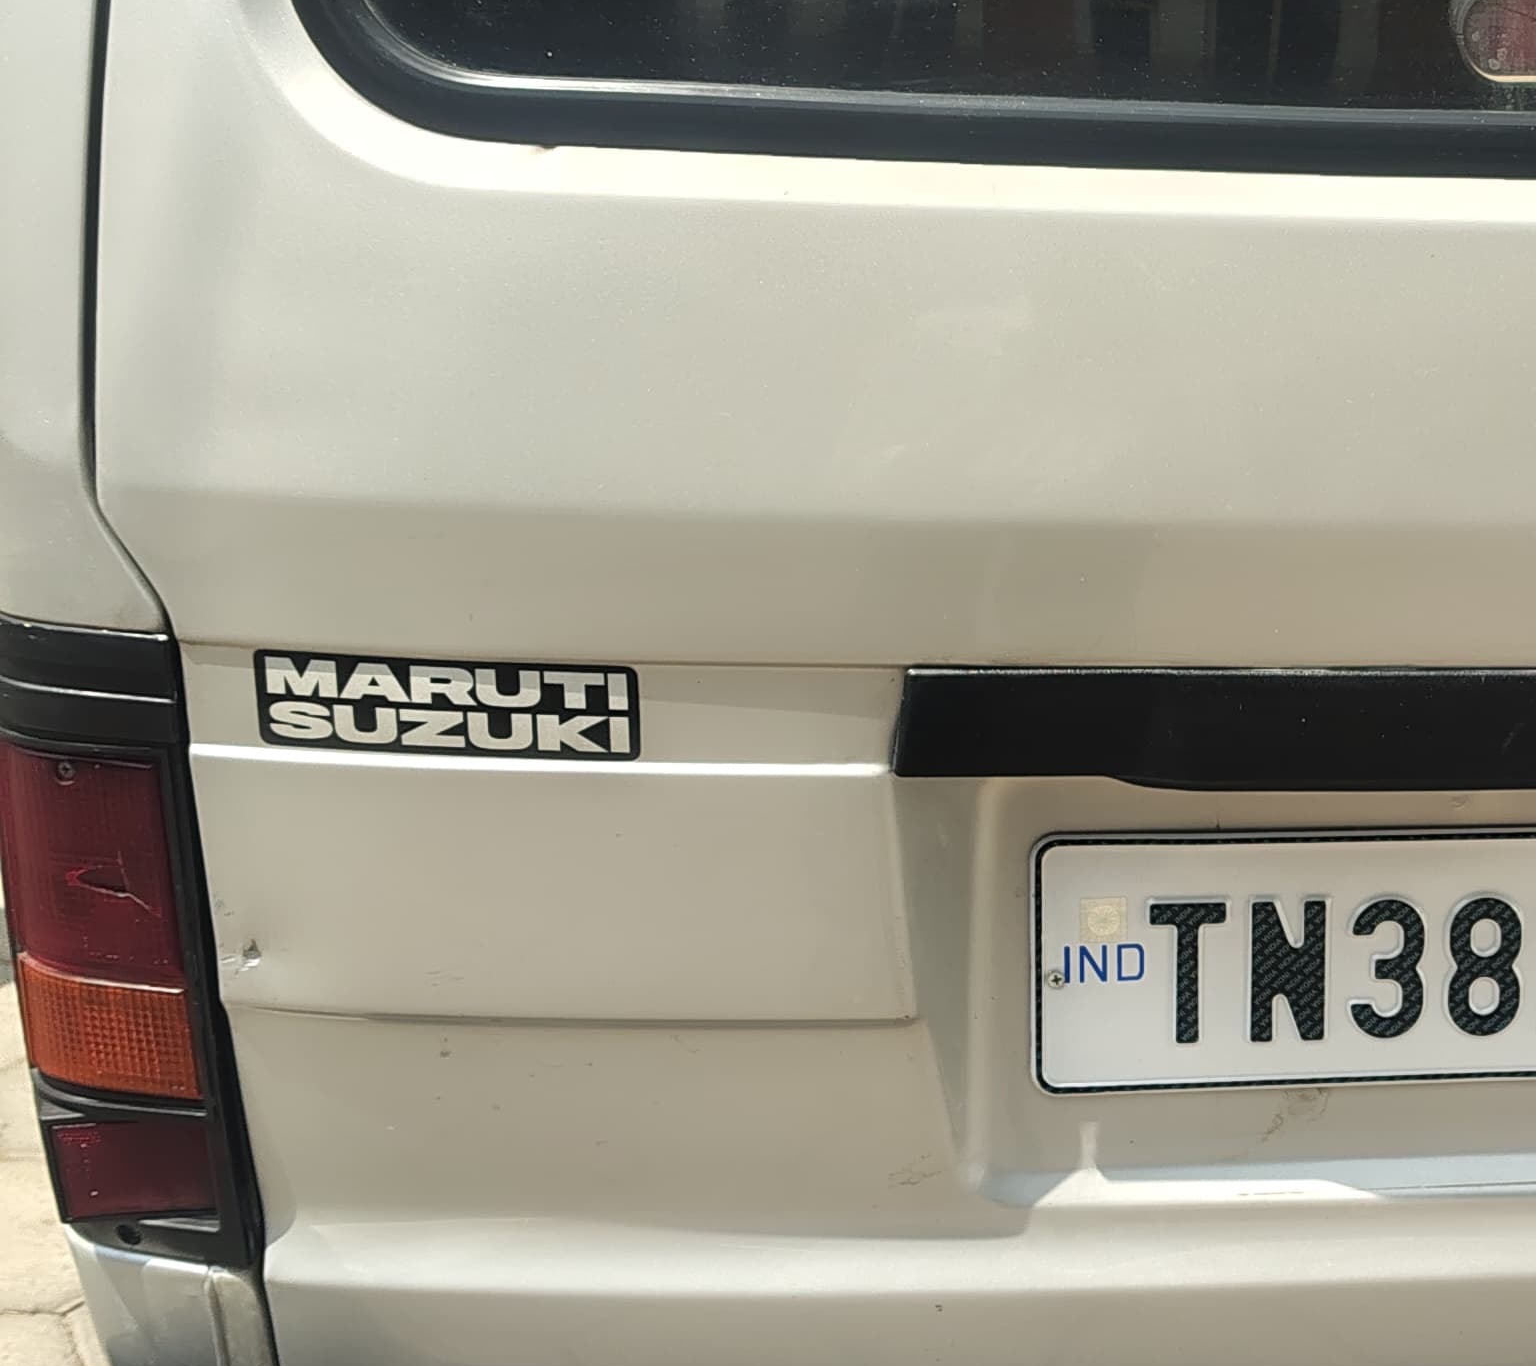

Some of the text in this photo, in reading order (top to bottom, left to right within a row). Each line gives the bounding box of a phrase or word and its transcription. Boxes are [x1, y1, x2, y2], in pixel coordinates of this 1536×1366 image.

[263, 655, 630, 711] MARUTI
[268, 700, 631, 754] SUZUKI
[1063, 943, 1145, 984] IND
